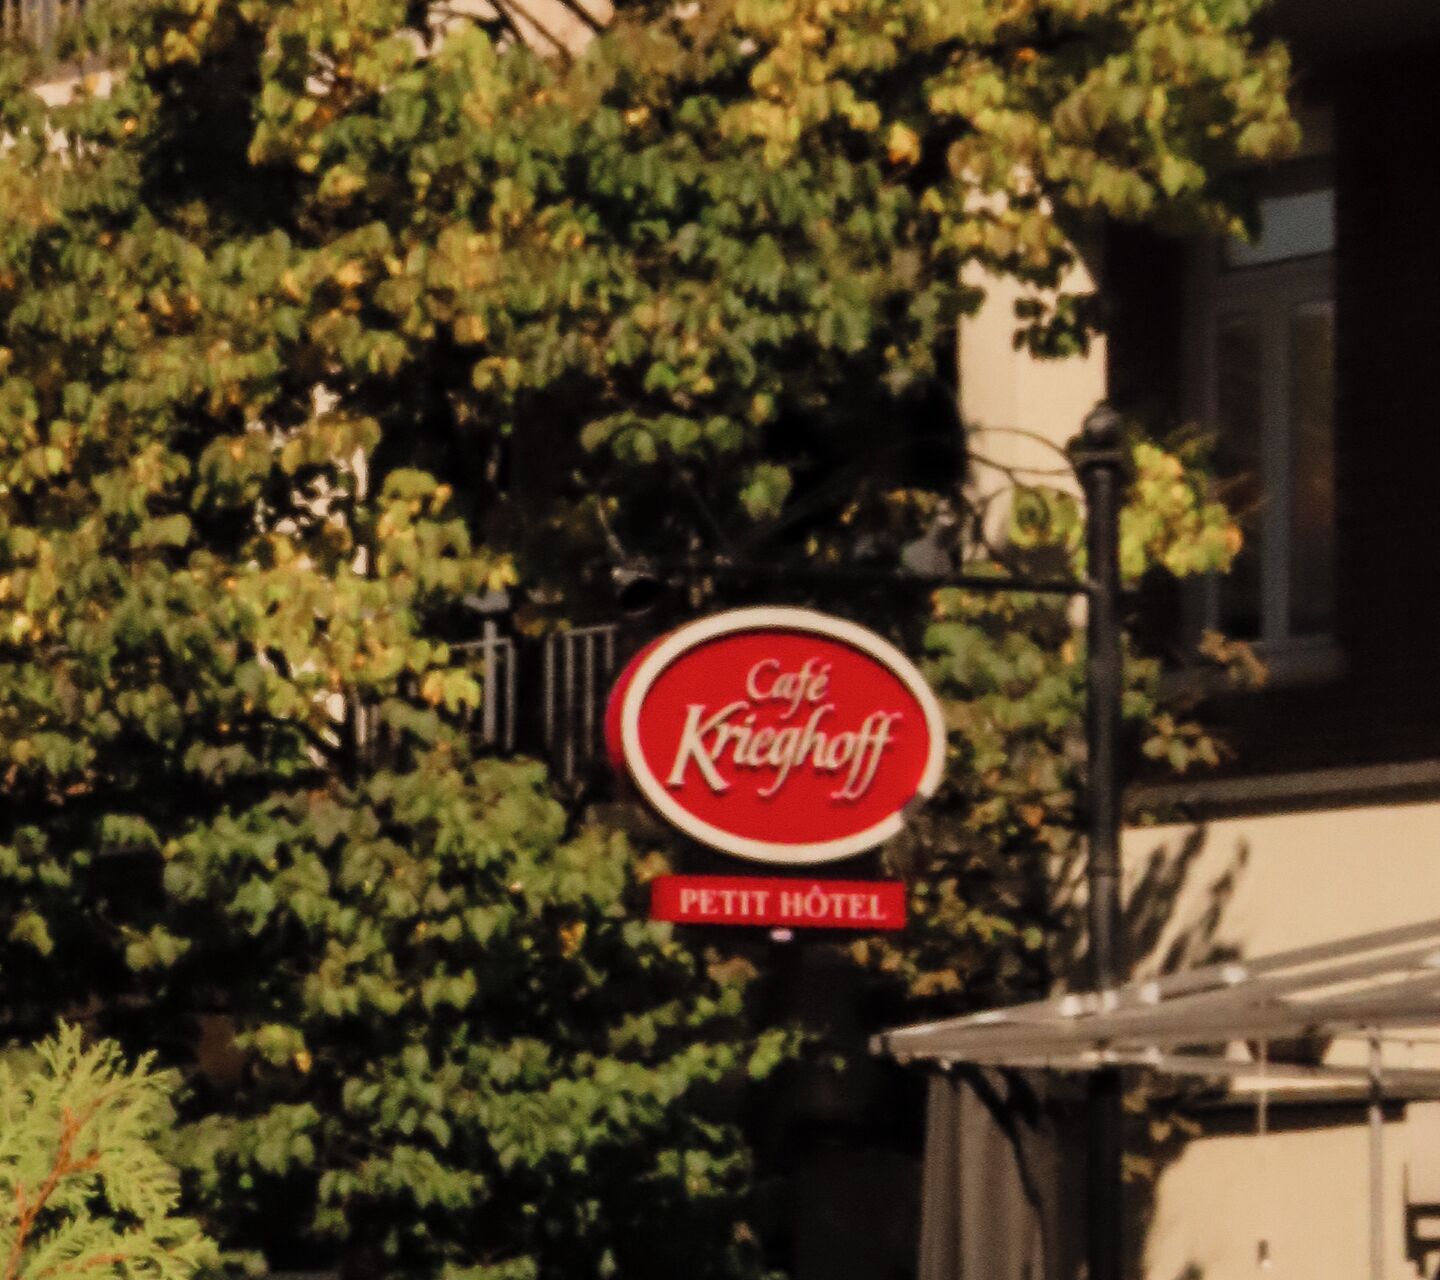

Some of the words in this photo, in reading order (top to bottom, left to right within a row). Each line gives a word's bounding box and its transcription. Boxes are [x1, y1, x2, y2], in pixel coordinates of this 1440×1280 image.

[746, 658, 832, 718] Café
[666, 702, 902, 800] Krieghoff
[679, 887, 769, 917] PETIT
[779, 884, 886, 921] HÔTEL
